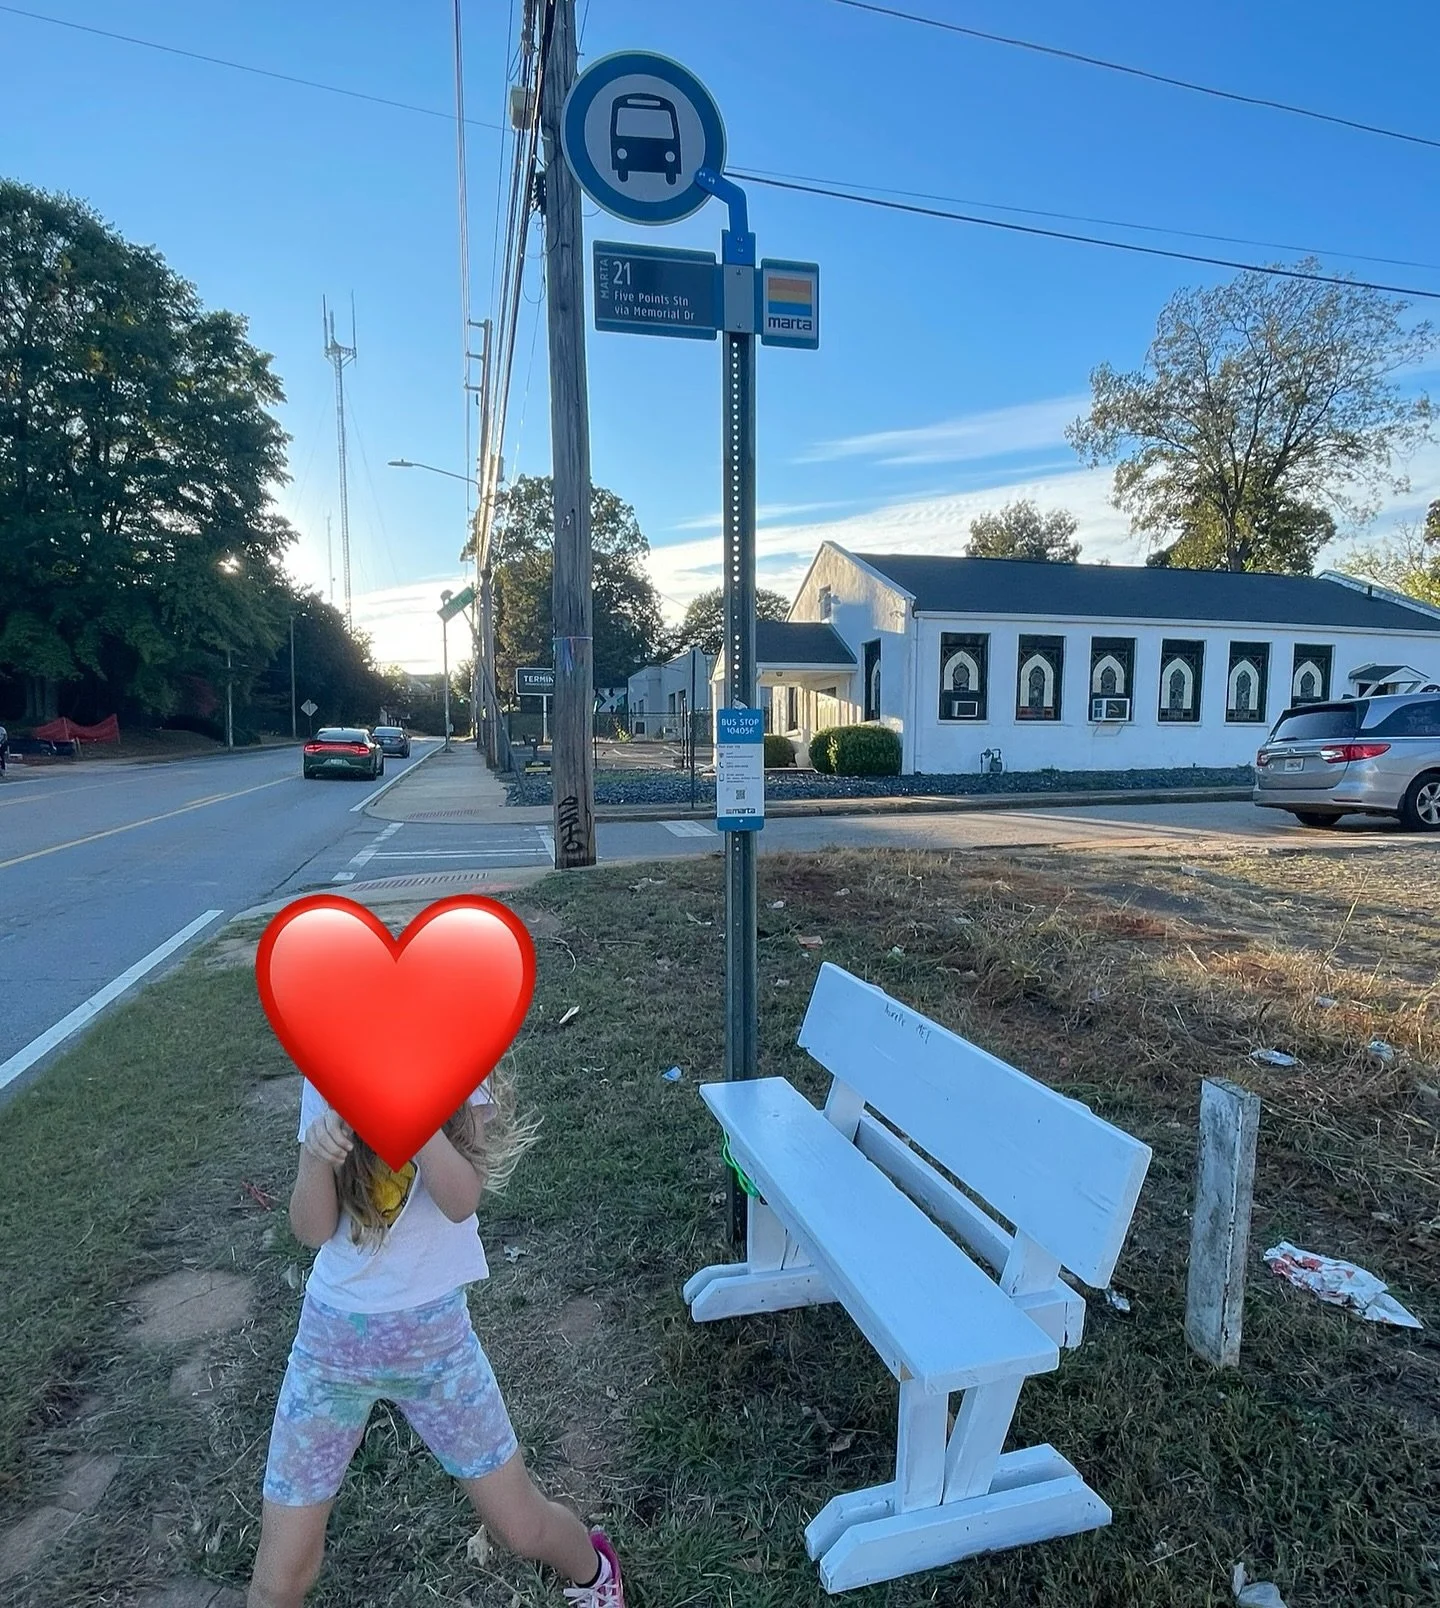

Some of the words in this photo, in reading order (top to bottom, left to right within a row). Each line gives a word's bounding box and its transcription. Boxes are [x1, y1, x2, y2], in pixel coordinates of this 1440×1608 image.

[599, 259, 609, 299] MARTA
[613, 261, 631, 285] 21
[614, 290, 634, 302] Five
[638, 293, 670, 305] Points
[673, 295, 689, 307] Stn
[614, 304, 629, 315] via
[633, 306, 680, 320] Memorial
[684, 310, 695, 320] Dr
[768, 316, 813, 331] marta
[523, 675, 554, 683] TERMIN
[721, 718, 737, 726] BUS
[739, 718, 760, 726] STOP
